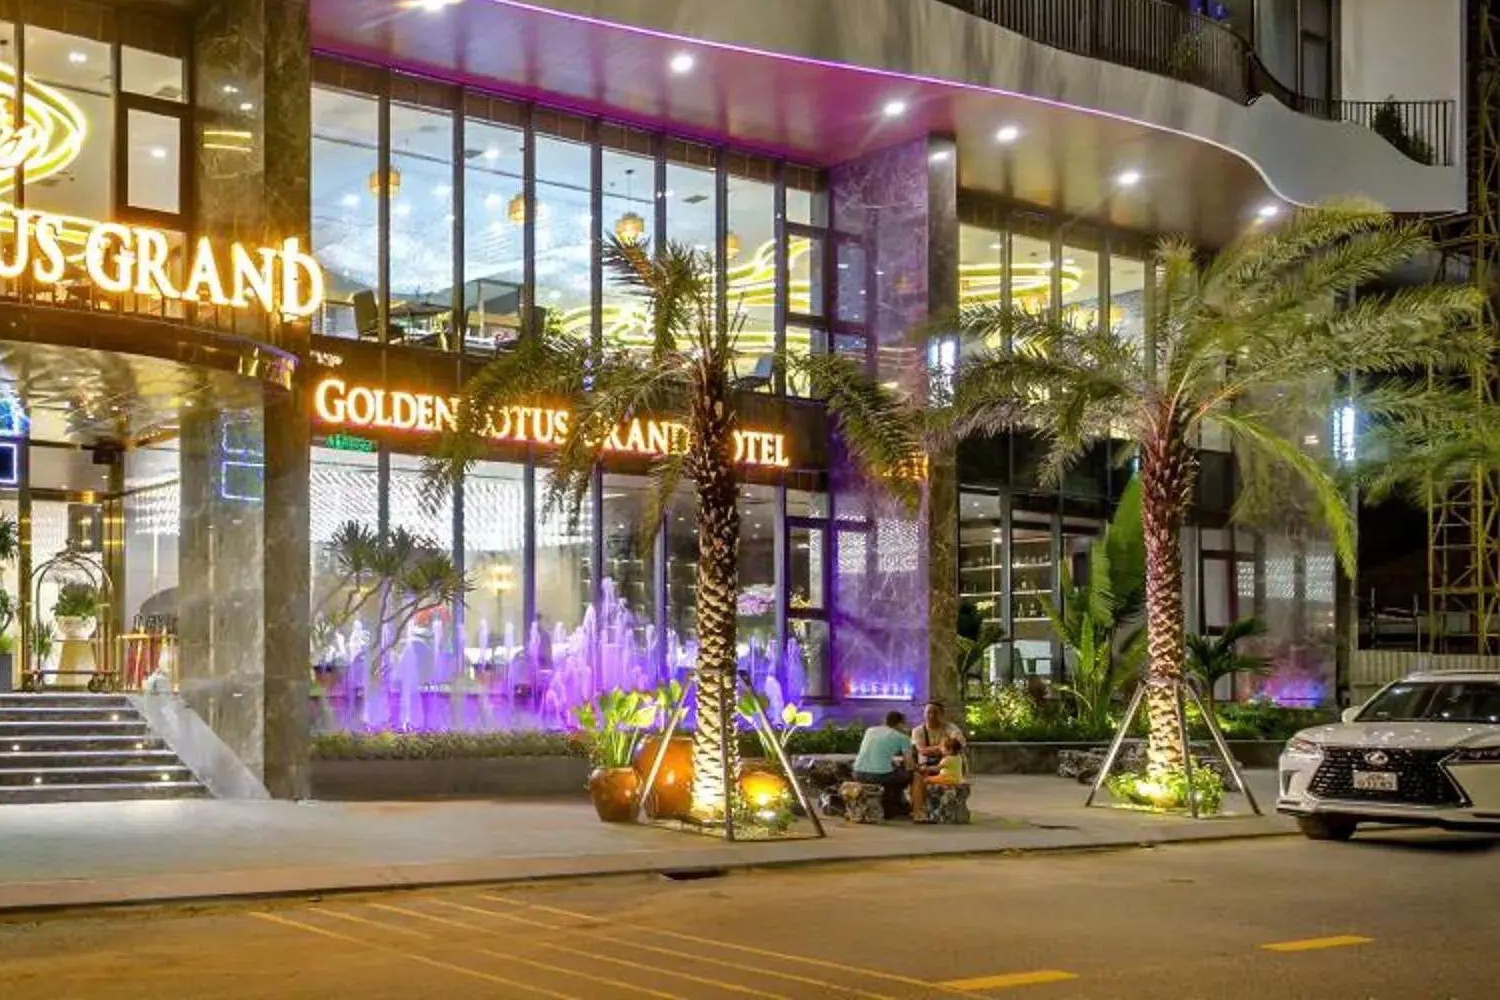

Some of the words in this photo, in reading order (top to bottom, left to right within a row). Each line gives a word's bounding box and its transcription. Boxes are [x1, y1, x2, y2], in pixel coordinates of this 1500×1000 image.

[85, 223, 325, 317] GRAND
[315, 378, 461, 433] GOLDEN
[733, 430, 789, 467] TEL
